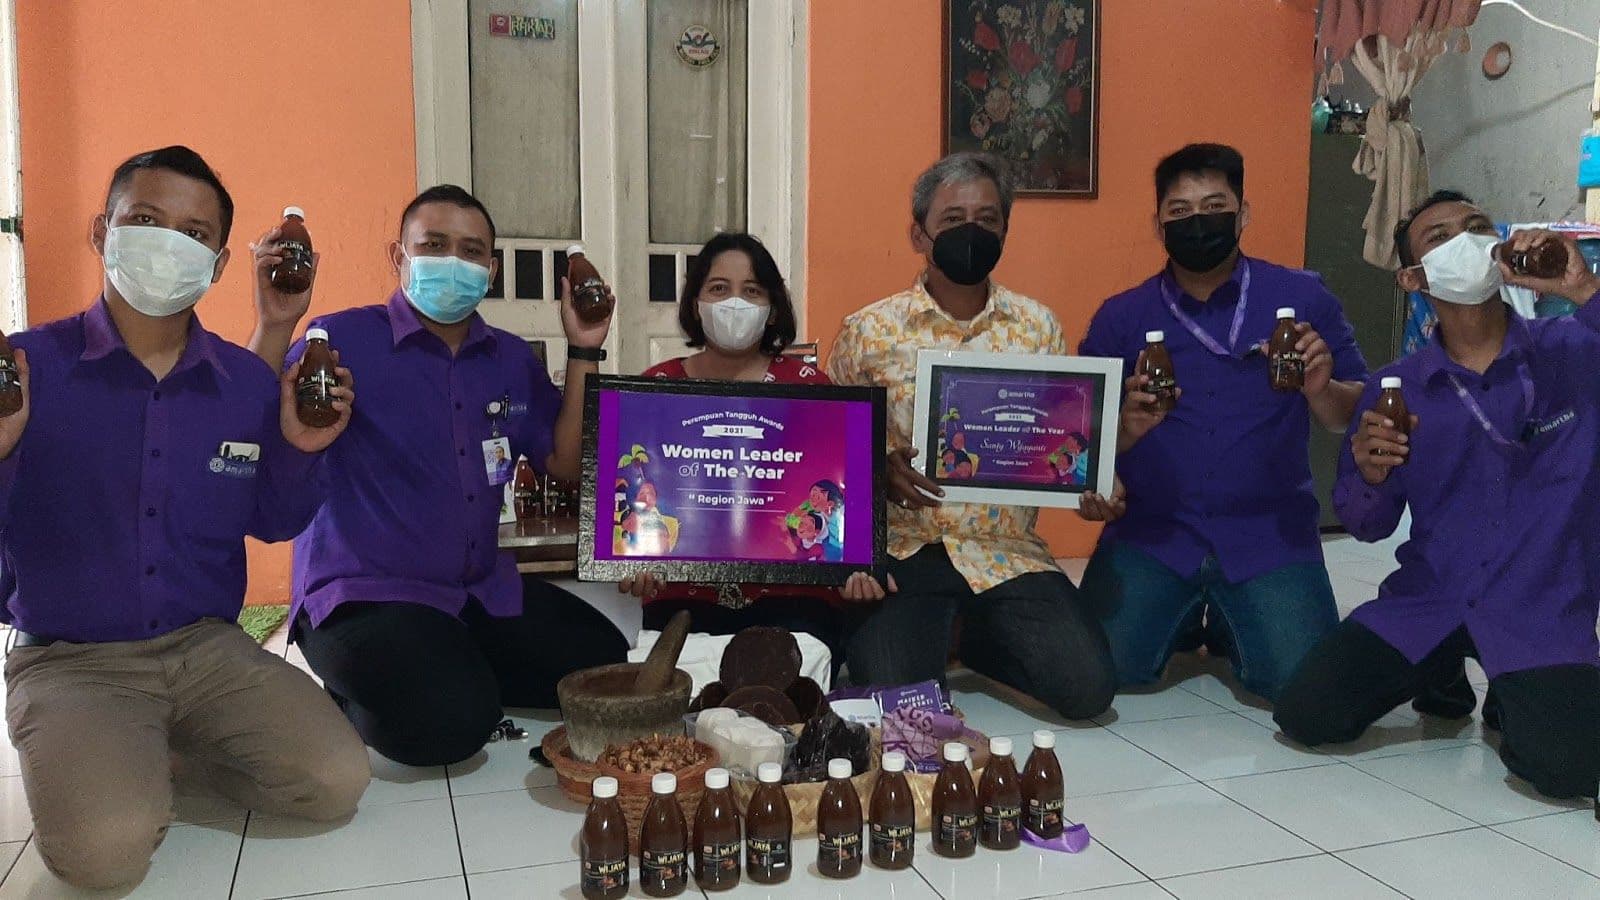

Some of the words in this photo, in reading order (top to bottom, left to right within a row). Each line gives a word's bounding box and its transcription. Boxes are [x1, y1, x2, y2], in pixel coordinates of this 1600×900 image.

[311, 375, 336, 385] WIAYA
[682, 412, 724, 427] Perempuan
[725, 411, 757, 421] Tangguh
[758, 416, 784, 431] Awards
[994, 425, 1020, 433] Leader
[661, 444, 734, 460] Women
[739, 447, 803, 463] Leader
[678, 463, 700, 477] of
[703, 464, 739, 478] The
[743, 465, 785, 479] Year
[698, 495, 735, 505] Region
[737, 496, 765, 505] Jawa
[657, 852, 685, 865] WIJAYA
[598, 860, 627, 875] WIJAYA
